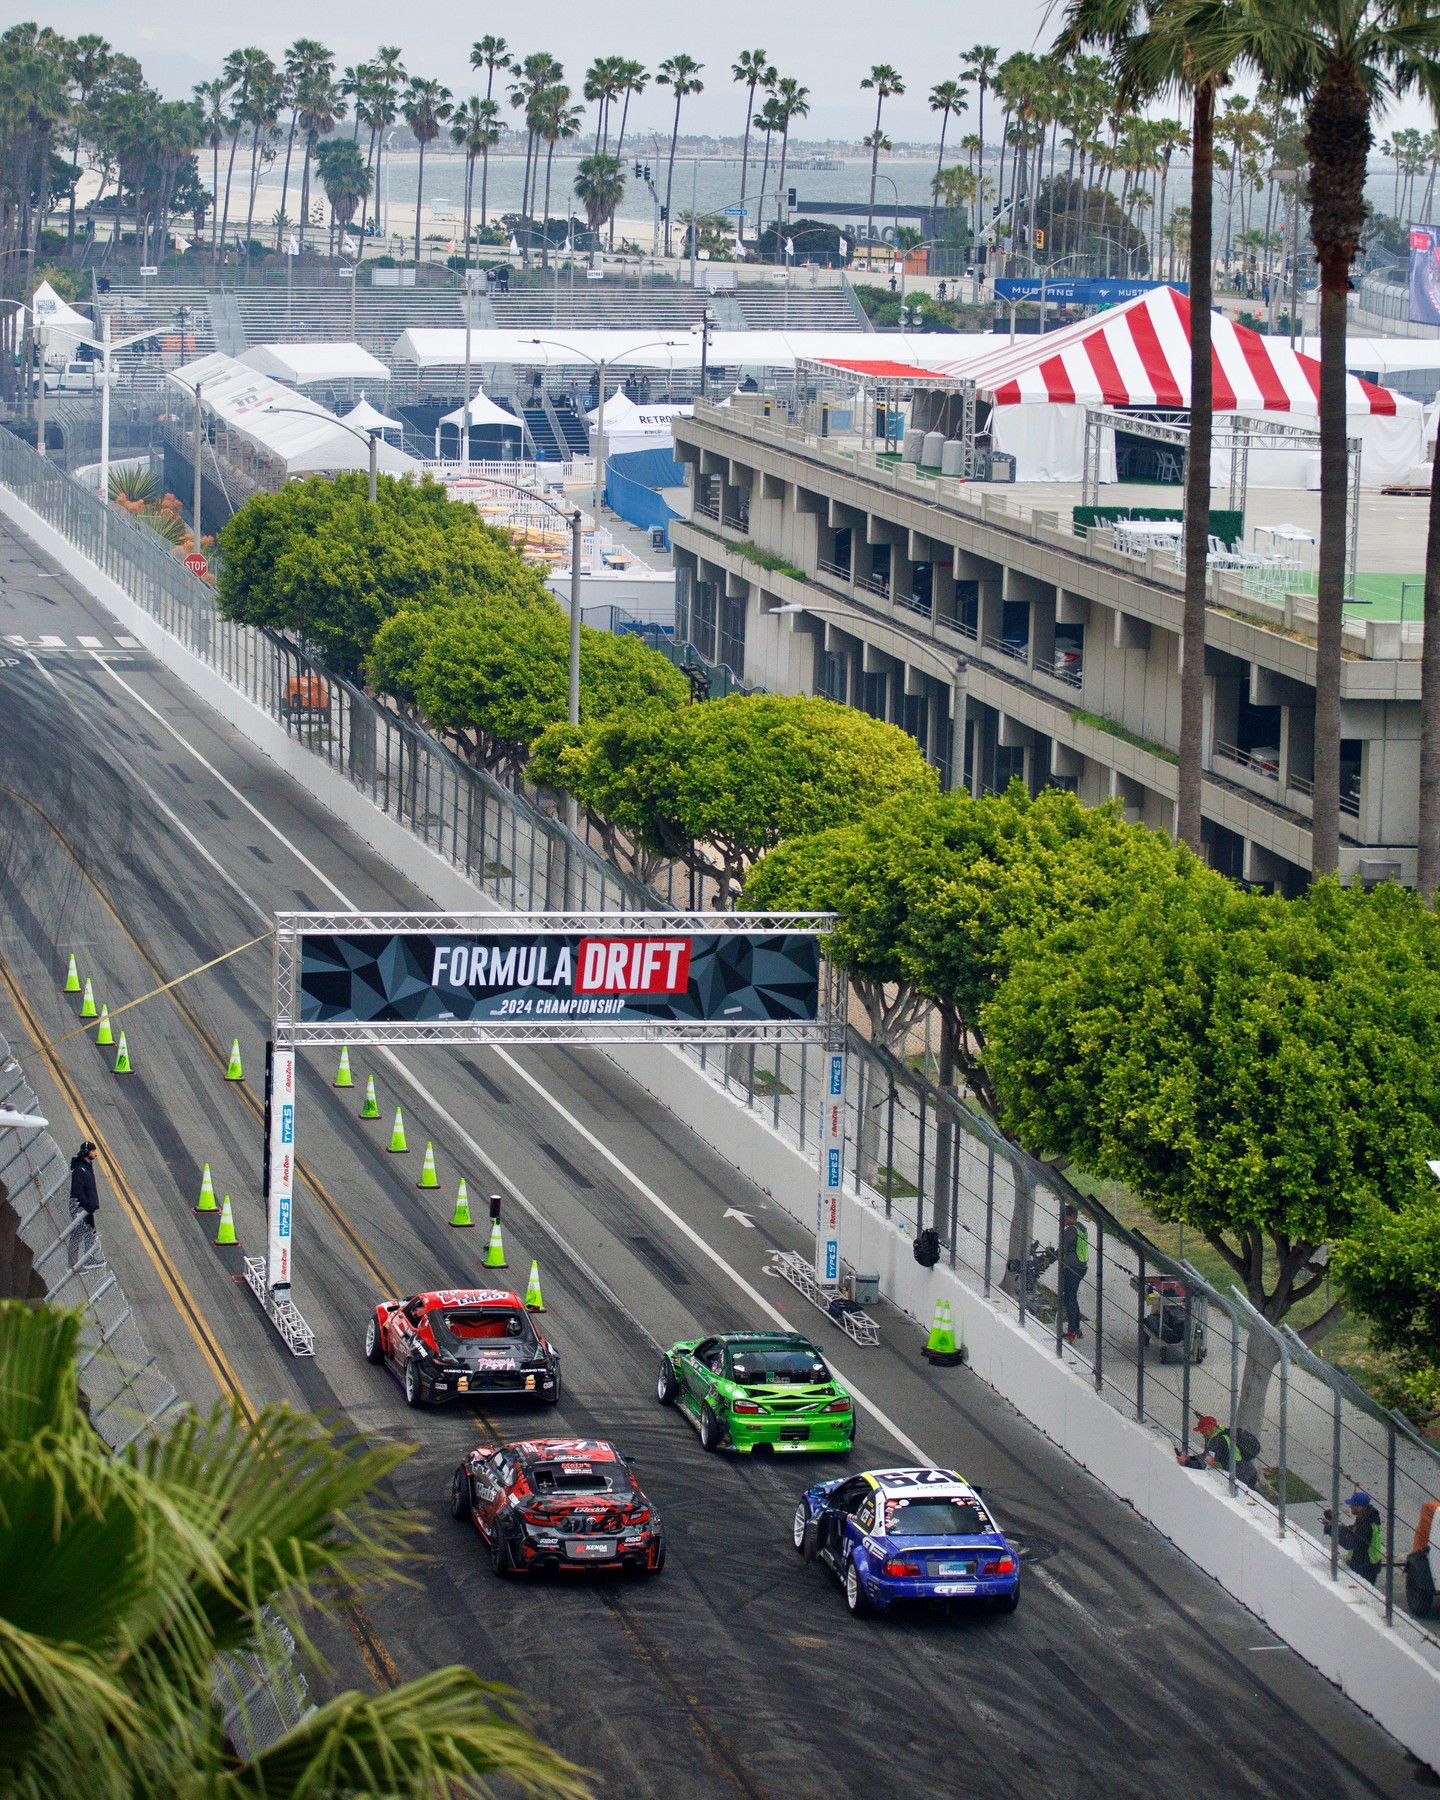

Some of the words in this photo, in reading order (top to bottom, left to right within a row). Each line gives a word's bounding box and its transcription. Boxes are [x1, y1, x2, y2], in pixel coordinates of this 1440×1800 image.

[845, 224, 896, 244] BEAC
[1012, 286, 1074, 297] MUSANG
[185, 561, 207, 571] STOP
[431, 946, 572, 987] FORMULA
[582, 942, 686, 990] DRIFT
[501, 999, 532, 1014] 2024
[536, 999, 625, 1014] CHAMPIONSHIP
[460, 1293, 507, 1305] ENERGY
